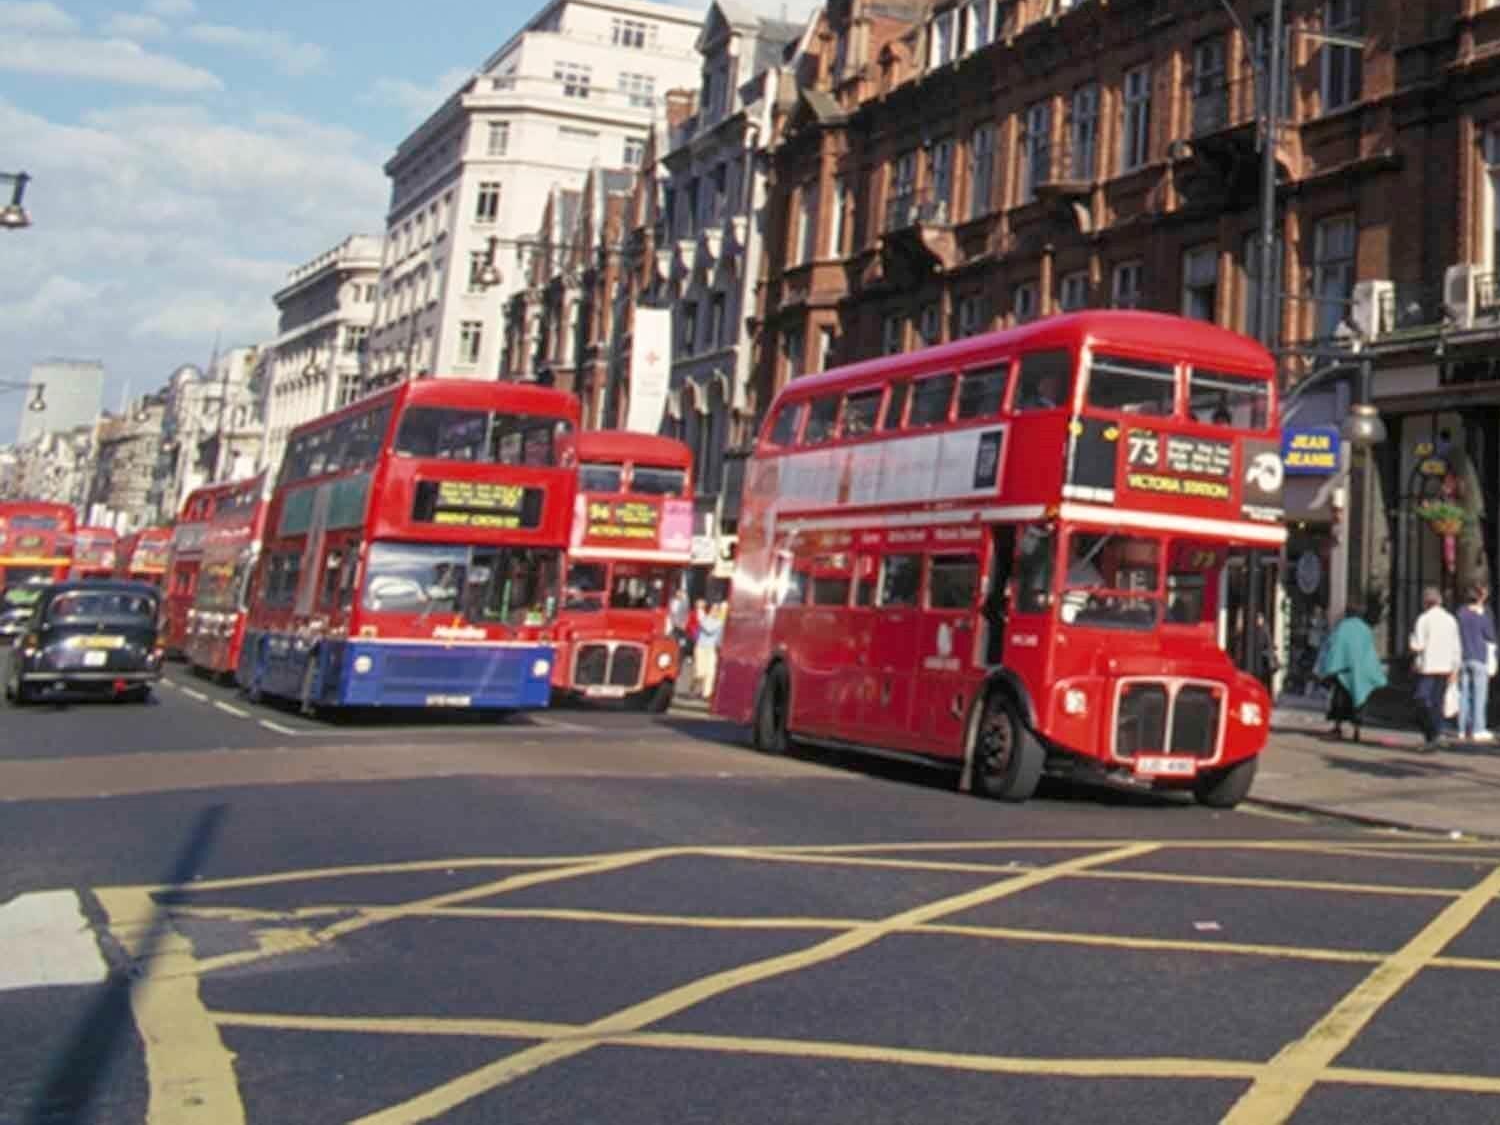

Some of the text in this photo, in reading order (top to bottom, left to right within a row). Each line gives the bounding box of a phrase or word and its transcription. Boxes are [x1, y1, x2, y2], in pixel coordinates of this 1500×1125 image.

[1128, 437, 1158, 465] 73
[1291, 435, 1329, 450] JEAN
[1128, 474, 1229, 498] VICTORIA STATION
